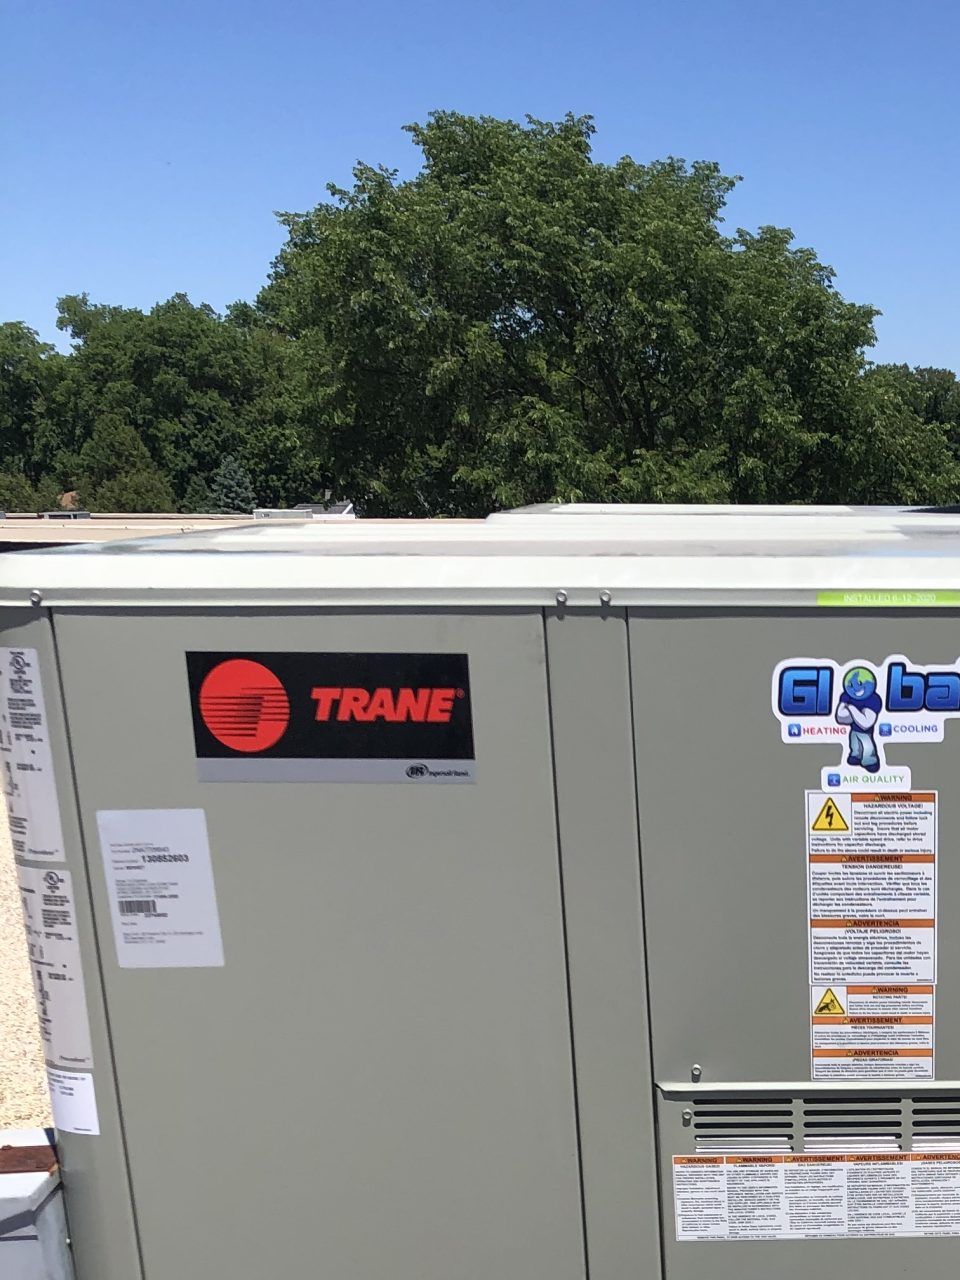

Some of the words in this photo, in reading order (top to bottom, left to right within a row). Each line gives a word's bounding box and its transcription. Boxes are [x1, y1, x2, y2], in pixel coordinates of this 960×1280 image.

[311, 687, 455, 721] TRANE
[803, 726, 847, 736] HEATING
[893, 724, 938, 733] COOLING
[842, 776, 859, 784] AIR
[862, 775, 905, 784] QUALITY
